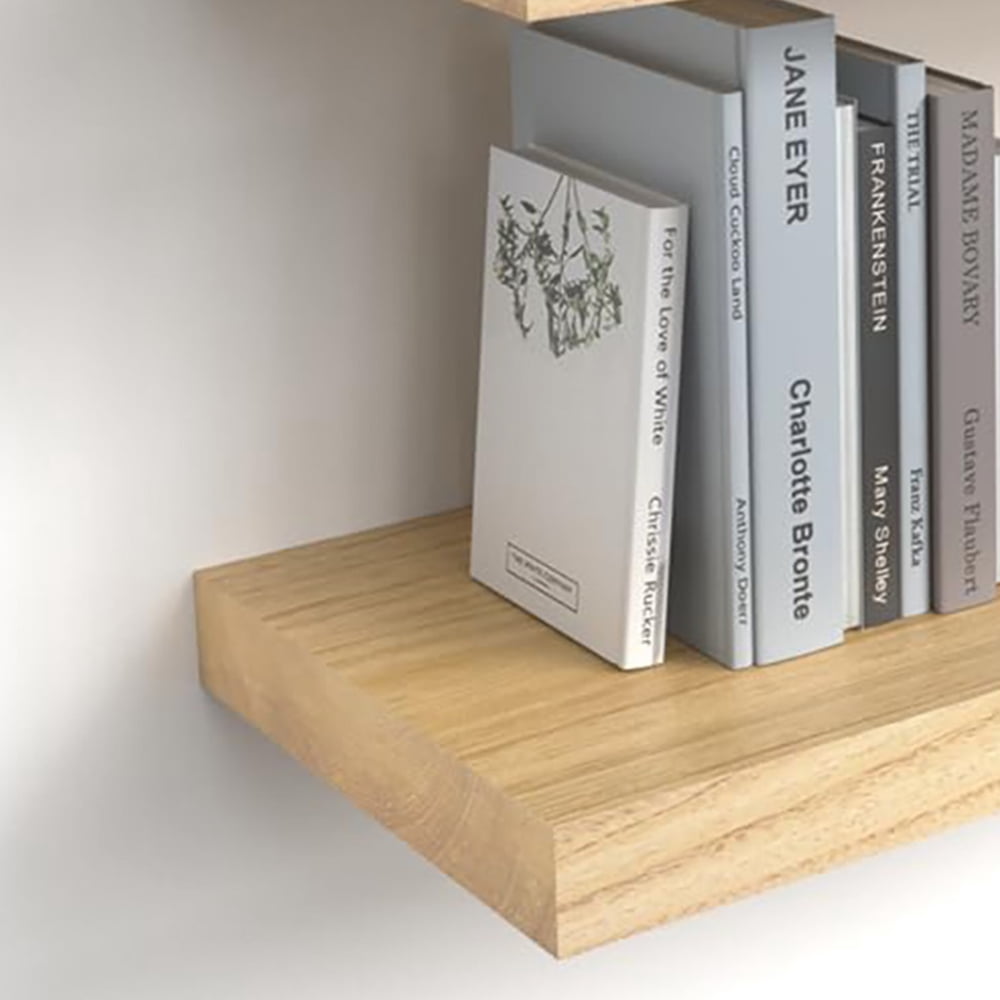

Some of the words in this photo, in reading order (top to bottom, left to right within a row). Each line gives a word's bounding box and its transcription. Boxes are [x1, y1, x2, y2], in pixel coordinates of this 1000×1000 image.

[783, 46, 807, 131] JANE
[907, 110, 921, 149] THE
[728, 146, 741, 198] Cloud
[785, 138, 809, 225] EYER
[907, 152, 922, 213] TRIAL
[961, 110, 979, 224] MADAME
[662, 227, 678, 258] For
[729, 204, 742, 272] Cuckoo
[870, 142, 888, 333] FRANKENSTEIN
[660, 266, 674, 299] the
[731, 277, 743, 321] Land
[961, 230, 980, 326] BOVARY
[656, 306, 673, 352] Love
[655, 359, 671, 379] of
[651, 385, 668, 446] White
[789, 378, 812, 514] Charlotte
[962, 408, 980, 496] Gustave
[871, 465, 889, 519] Mary
[910, 467, 923, 514] Franz
[644, 496, 662, 574] Chrissie
[734, 498, 748, 573] Anthony
[873, 525, 890, 604] Shelley
[911, 517, 924, 567] Kafka
[963, 502, 981, 596] Flaubert
[737, 577, 748, 625] Doerr
[792, 522, 814, 621] Bronte
[641, 580, 657, 645] Rucker
